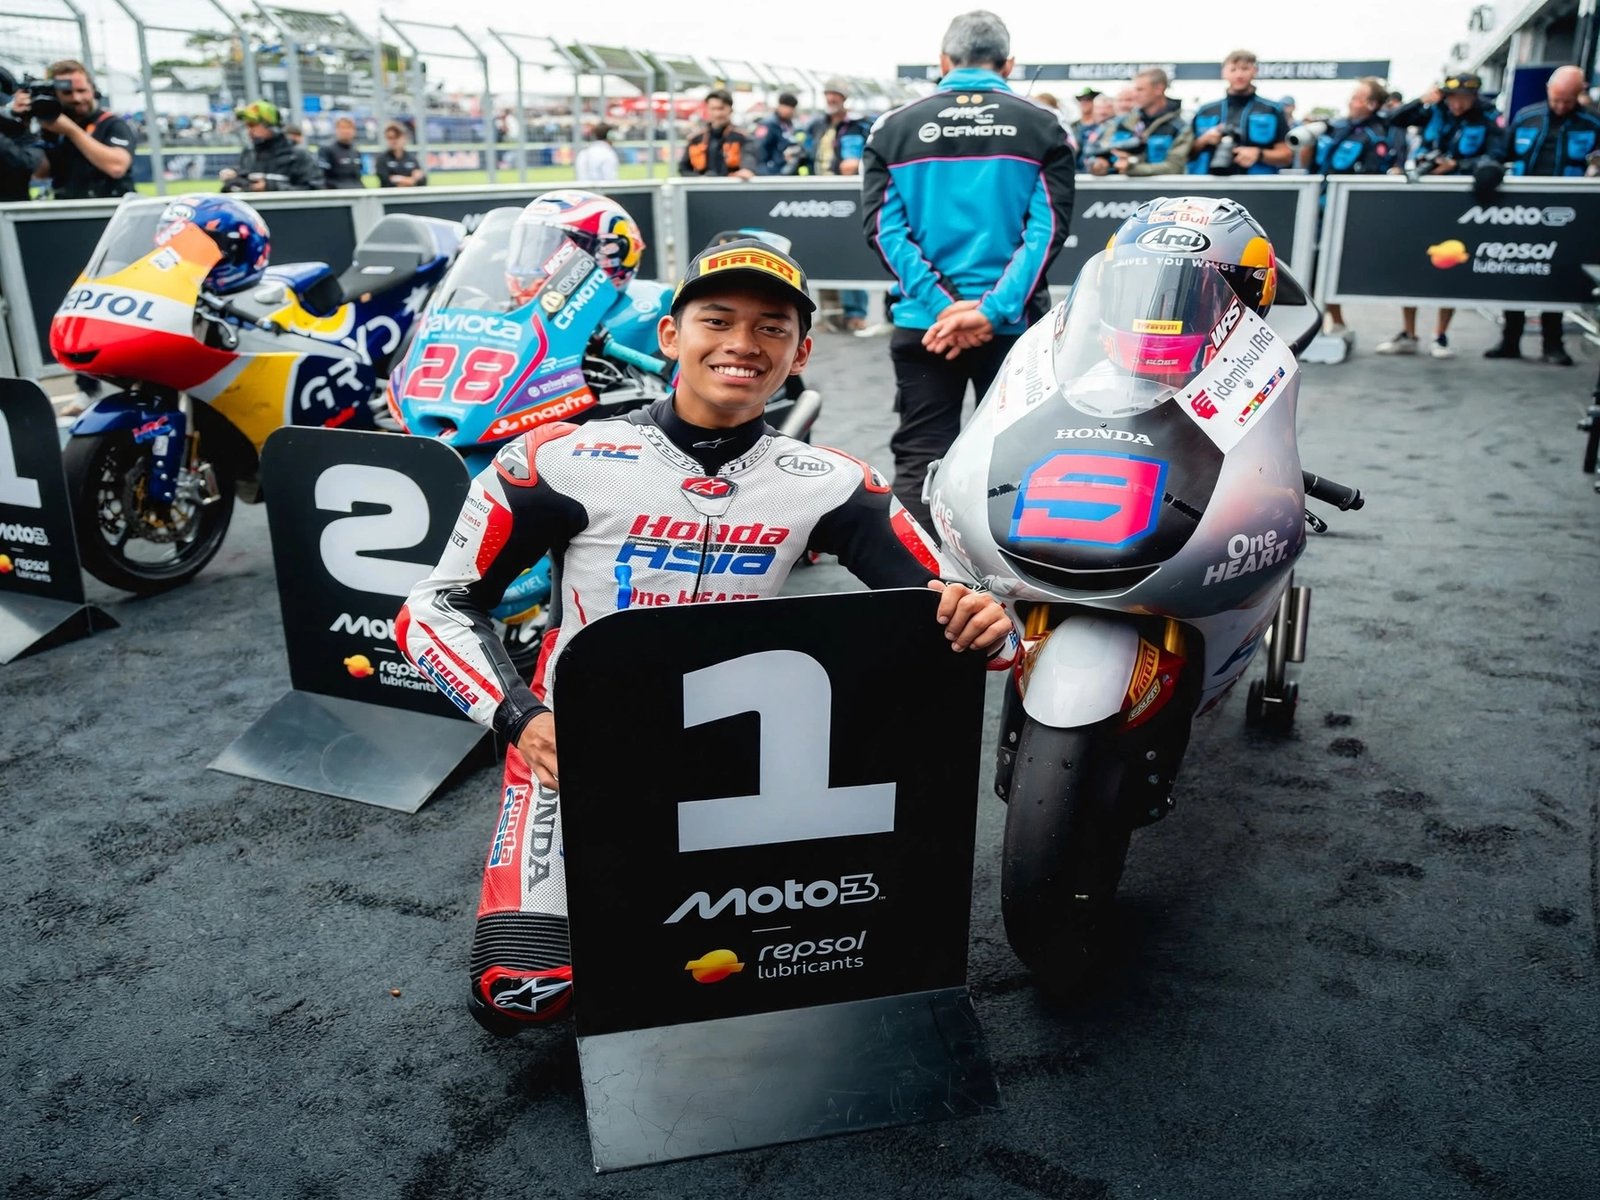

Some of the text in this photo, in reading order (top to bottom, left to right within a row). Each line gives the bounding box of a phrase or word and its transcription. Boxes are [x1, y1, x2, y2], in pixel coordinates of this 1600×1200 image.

[942, 124, 1018, 137] CFMOTO
[1179, 212, 1210, 226] Bull
[1146, 228, 1203, 247] Arai
[1475, 240, 1558, 261] repsol
[708, 251, 794, 281] PIRELLI
[1156, 258, 1184, 267] YOU
[1472, 258, 1552, 275] lubricants
[62, 289, 154, 321] EPSOL
[554, 268, 608, 330] CFMOTO
[421, 314, 522, 341] aviota
[1211, 299, 1241, 349] WRS
[405, 344, 519, 405] 28
[1207, 326, 1275, 401] idemitsu IRG
[520, 393, 594, 427] mapfre
[1055, 427, 1155, 447] HONDA
[572, 442, 643, 464] HRC
[785, 456, 829, 473] Arai
[1010, 450, 1167, 548] 9
[314, 463, 434, 597] 2
[629, 514, 791, 546] Honda
[1227, 529, 1278, 559] One
[15, 557, 50, 573] repsol
[1202, 539, 1289, 587] HEART.
[379, 660, 420, 679] reps
[379, 673, 438, 694] lubricants
[424, 647, 480, 705] Honda
[678, 649, 897, 853] 1
[500, 785, 529, 865] Honda
[528, 783, 559, 892] ONDA
[758, 930, 867, 963] repsol
[758, 955, 865, 980] lubricants
